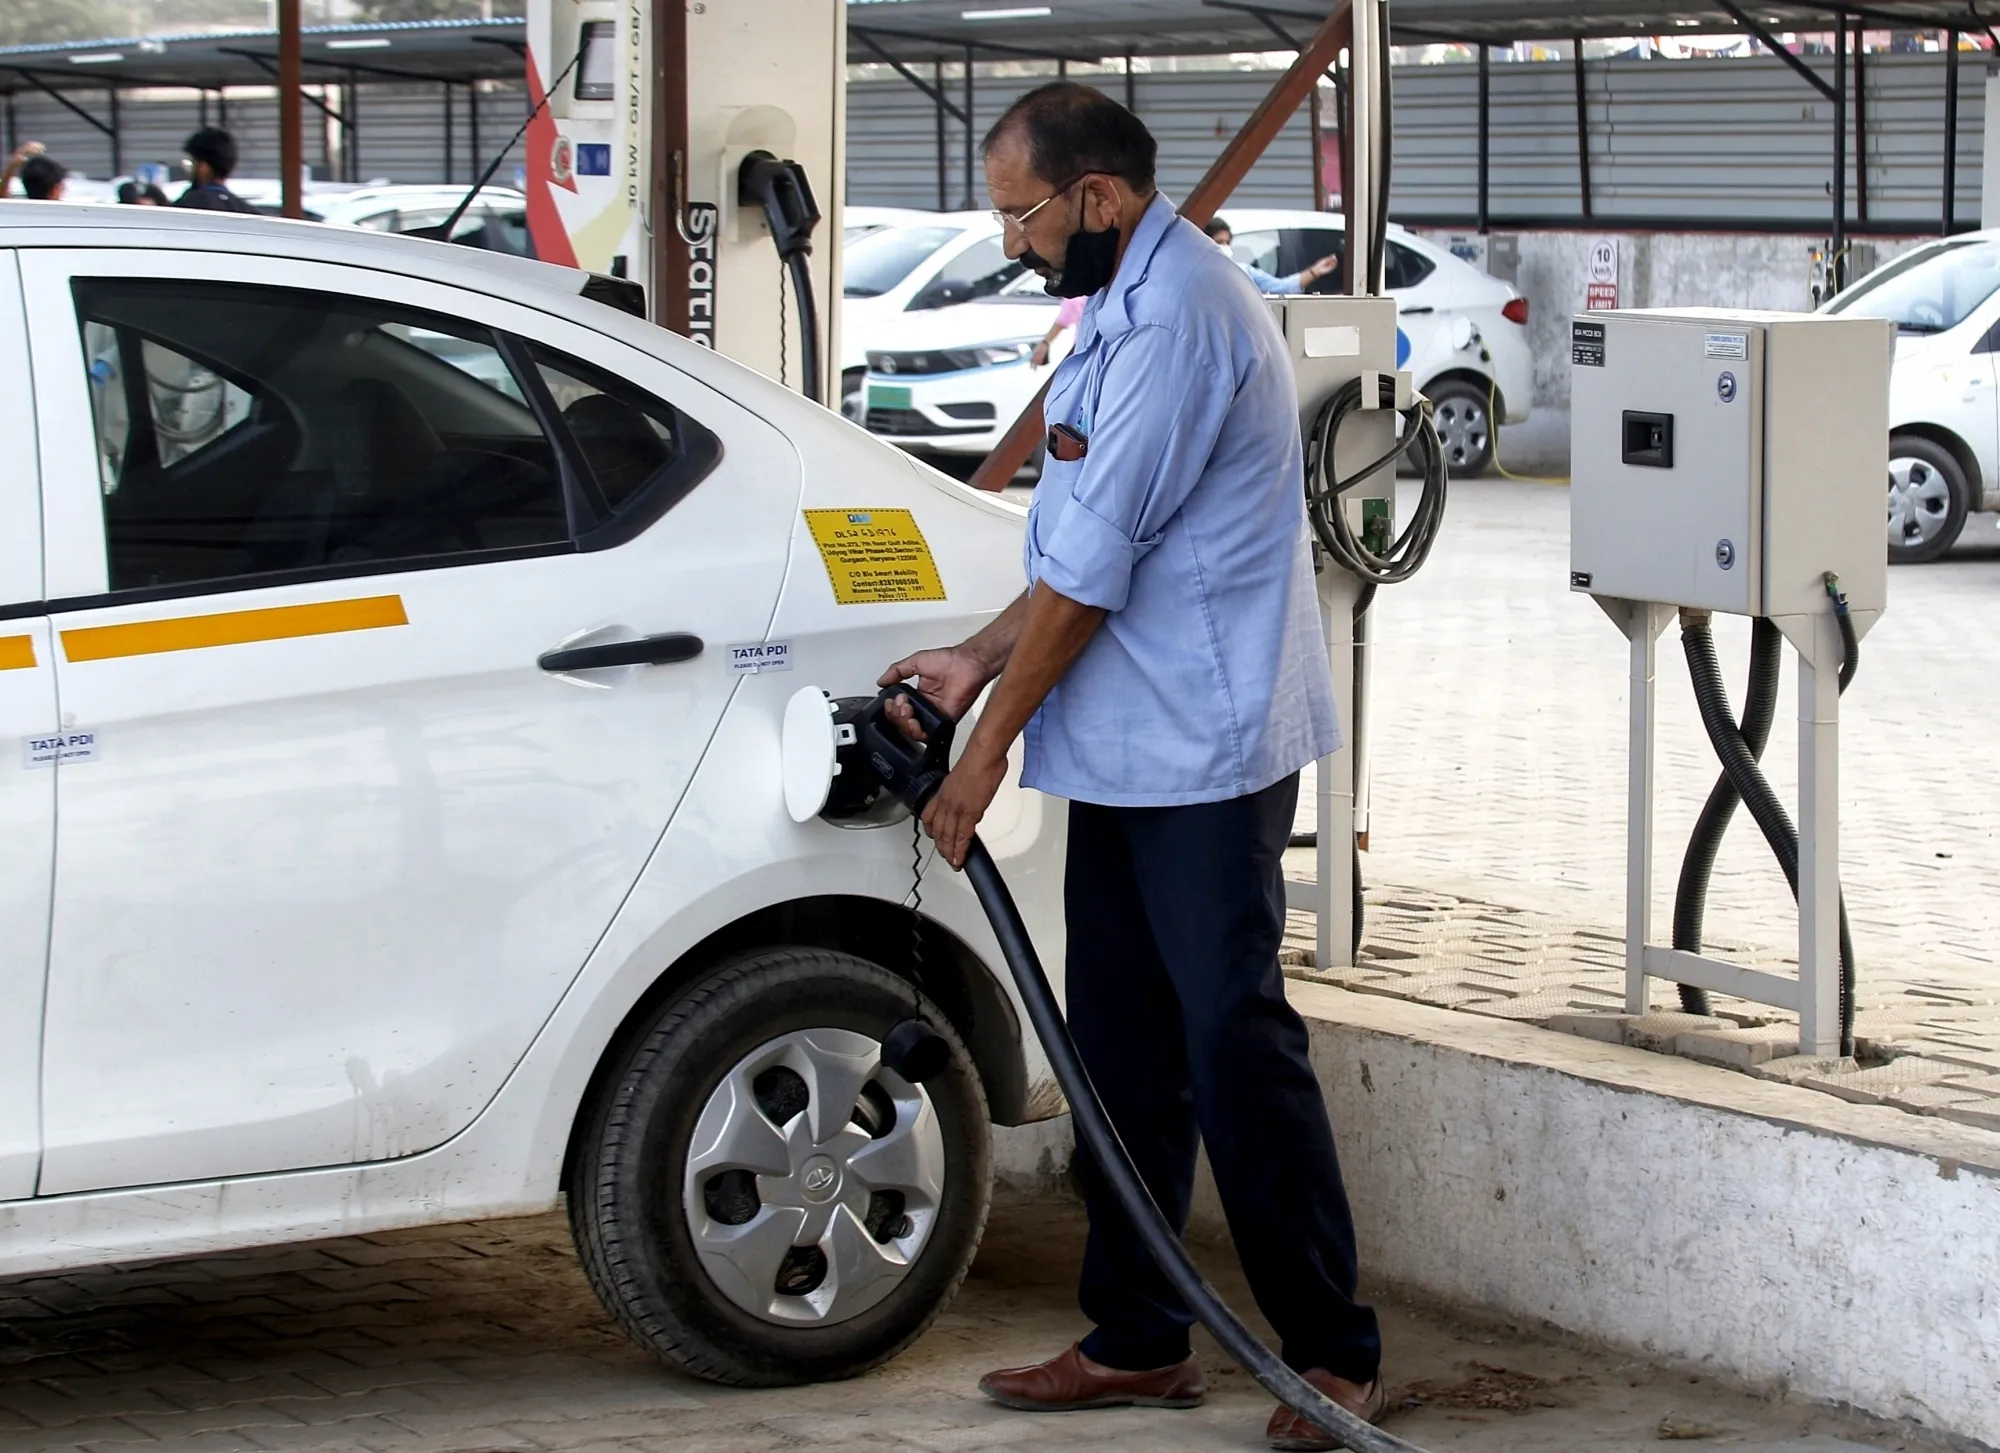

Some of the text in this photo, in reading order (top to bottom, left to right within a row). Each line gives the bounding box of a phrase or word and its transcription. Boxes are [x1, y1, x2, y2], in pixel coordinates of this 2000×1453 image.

[630, 0, 640, 46] GB/
[630, 71, 640, 124] GB/T
[628, 186, 637, 208] 30
[1598, 248, 1610, 262] 10
[1590, 286, 1615, 298] SPEED
[1590, 299, 1612, 310] LIMIT
[733, 645, 787, 658] TATA PDI
[29, 734, 94, 750] TATA PDI
